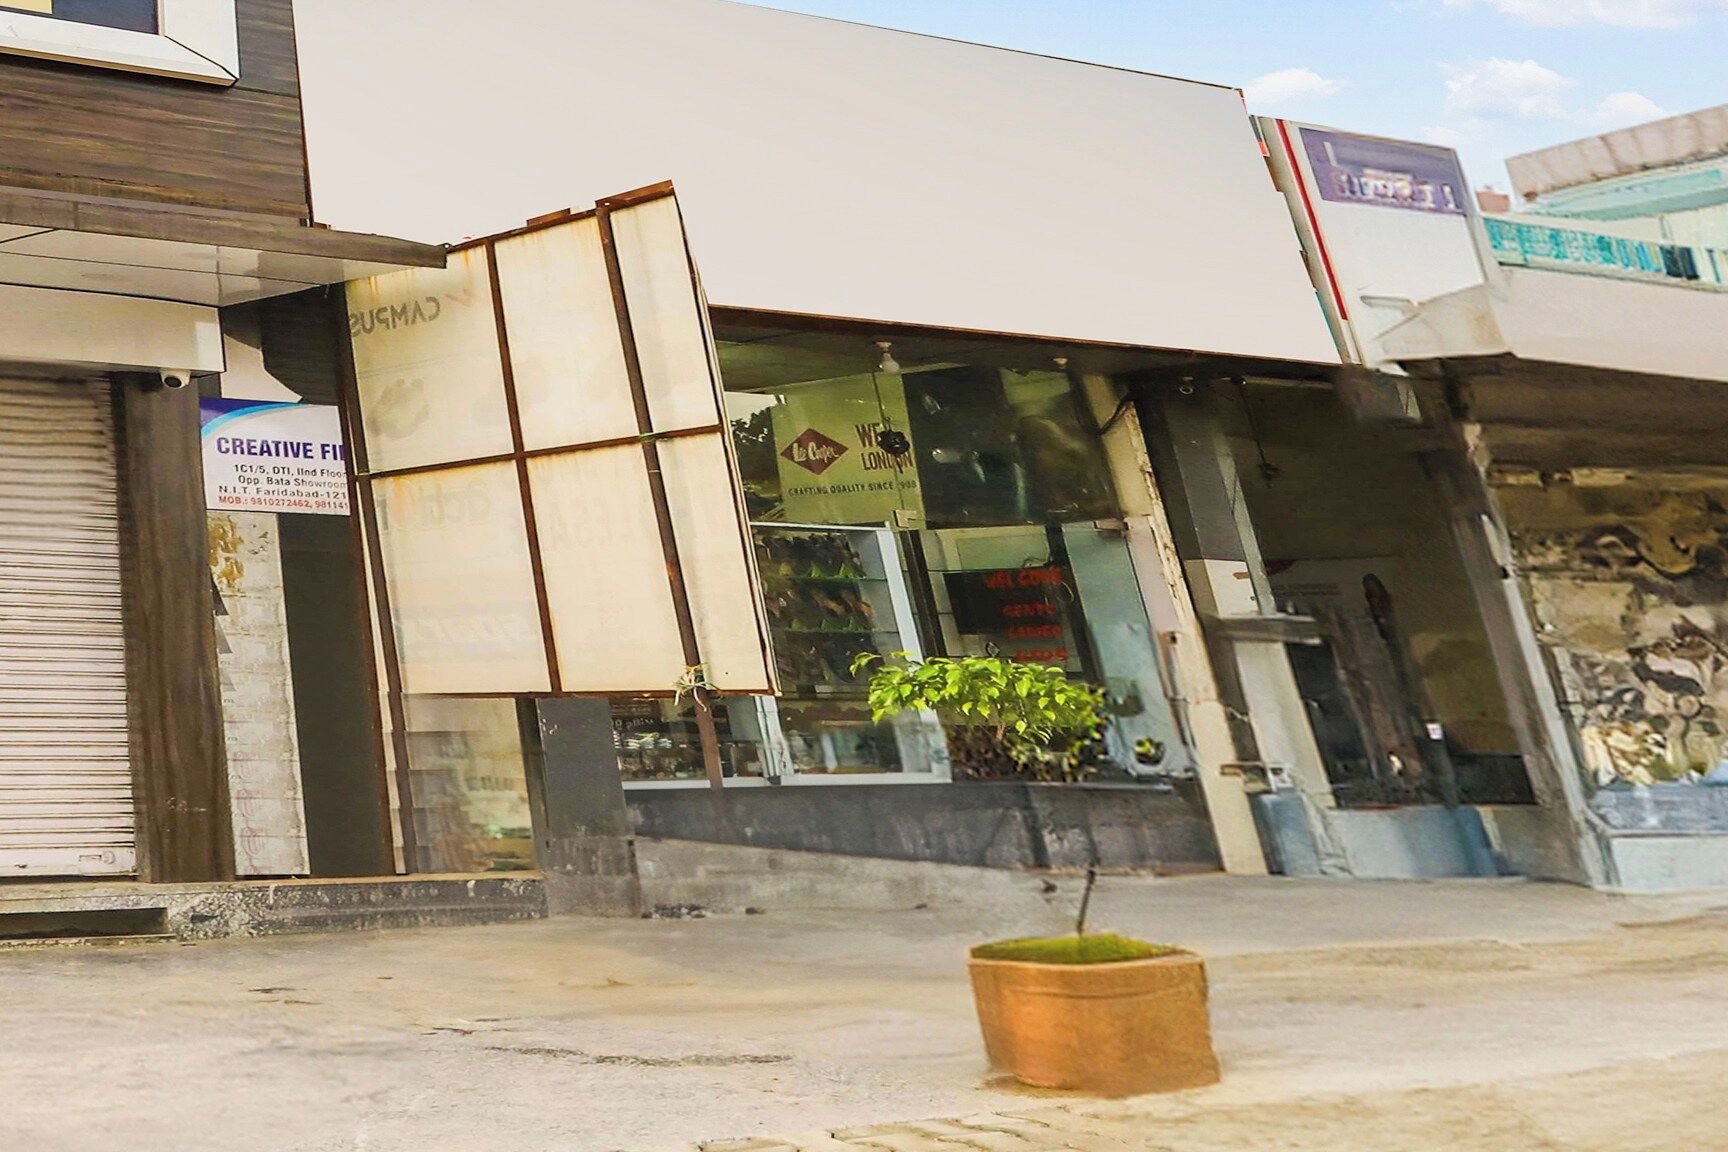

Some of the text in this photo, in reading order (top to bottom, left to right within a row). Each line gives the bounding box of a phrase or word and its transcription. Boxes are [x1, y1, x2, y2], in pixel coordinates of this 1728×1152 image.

[215, 436, 315, 460] CREATIVE
[266, 476, 291, 486] Bata
[829, 483, 866, 494] QUALITY
[868, 481, 894, 491] SINCE
